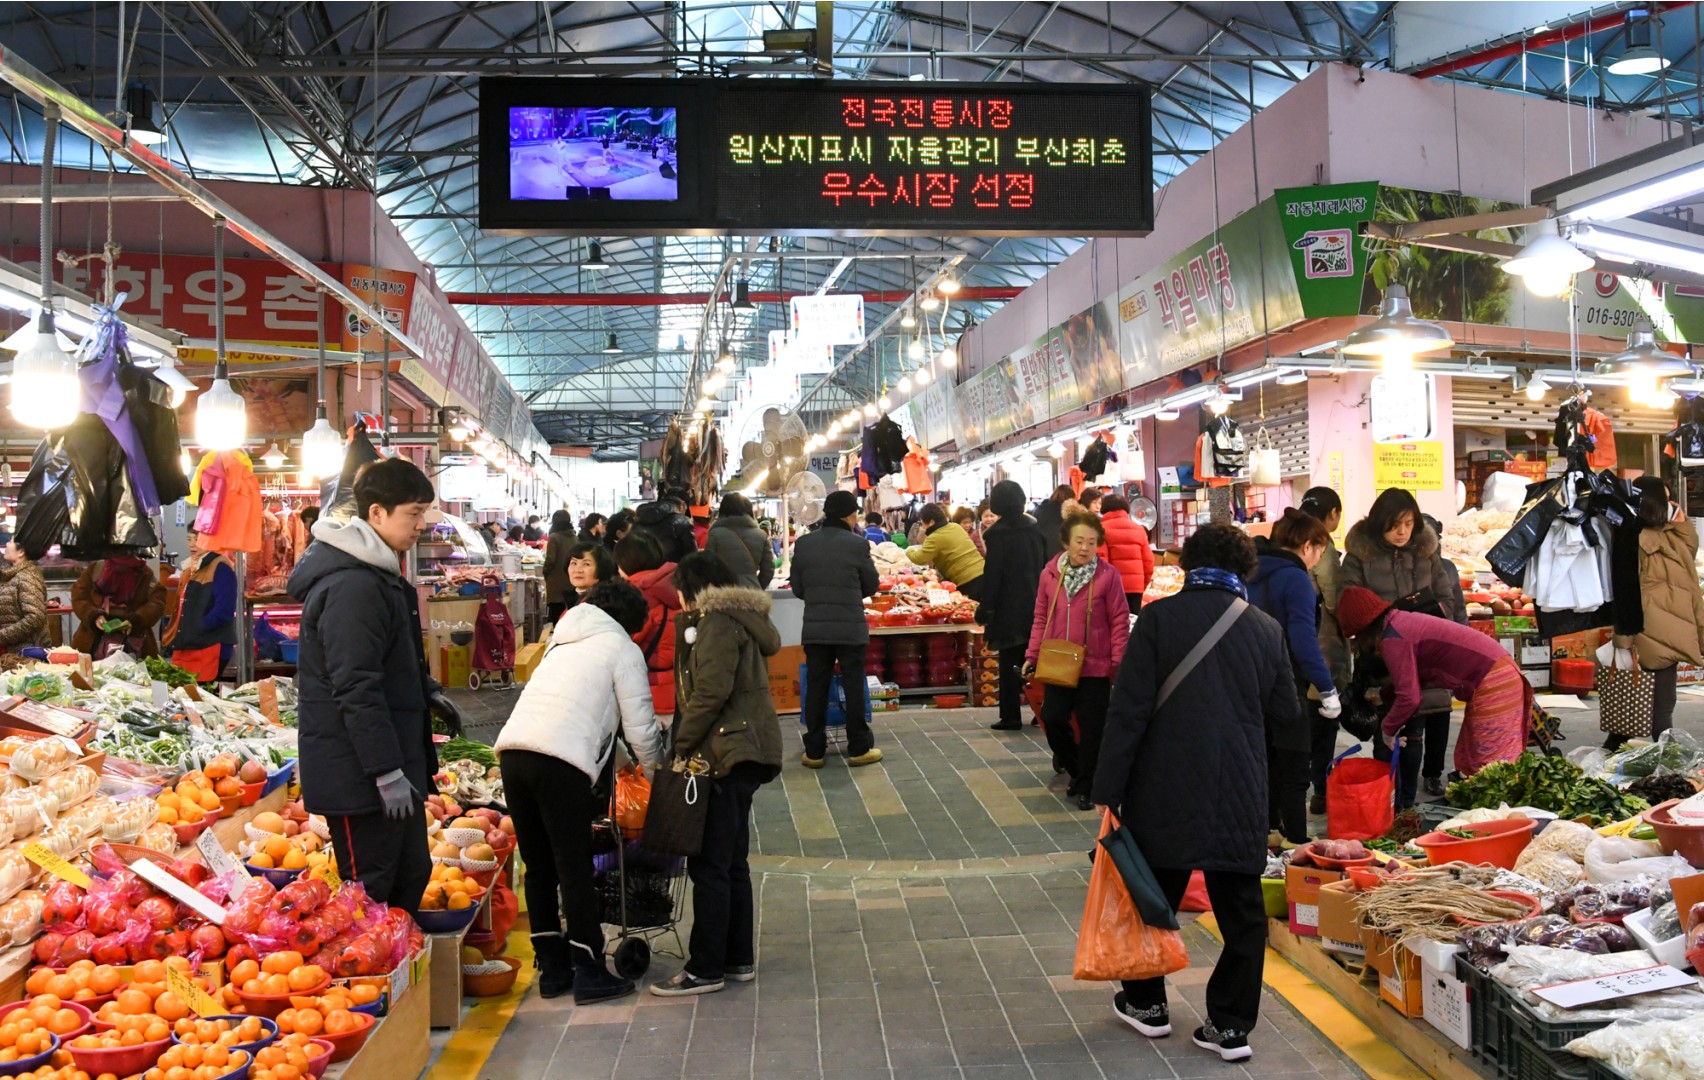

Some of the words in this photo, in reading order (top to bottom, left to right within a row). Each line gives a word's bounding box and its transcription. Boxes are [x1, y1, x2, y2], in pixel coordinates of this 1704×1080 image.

[842, 98, 1013, 128] 전국전통시장
[729, 135, 872, 164] 원산지표시
[888, 136, 999, 165] 자율관리
[1015, 137, 1126, 166] 부산최초
[822, 172, 959, 207] 우수시장
[971, 173, 1034, 207] 선정
[1286, 197, 1367, 217] 좌동재래시장
[1153, 242, 1236, 334] 과일마당
